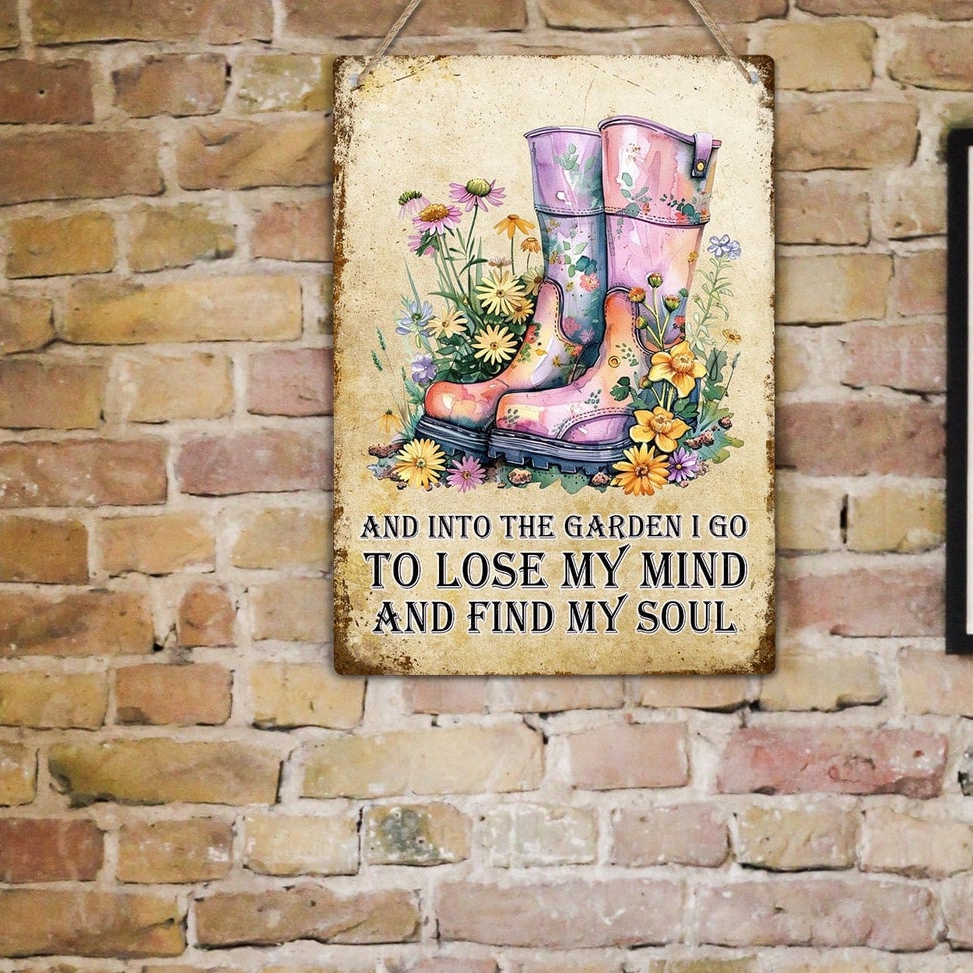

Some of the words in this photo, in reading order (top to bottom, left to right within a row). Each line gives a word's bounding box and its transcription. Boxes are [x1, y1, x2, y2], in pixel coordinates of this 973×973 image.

[360, 514, 419, 539] AND
[428, 514, 492, 539] INTO
[501, 514, 555, 539] THE
[564, 514, 684, 540] GARDEN
[692, 514, 700, 539] I
[708, 514, 748, 539] GO
[363, 551, 421, 590] TO
[436, 551, 547, 590] LOSE
[561, 543, 630, 590] MY
[640, 551, 749, 590] MIND
[371, 600, 454, 634] AND
[467, 600, 555, 634] FIND
[567, 593, 629, 634] MY
[636, 600, 737, 634] SOUL
